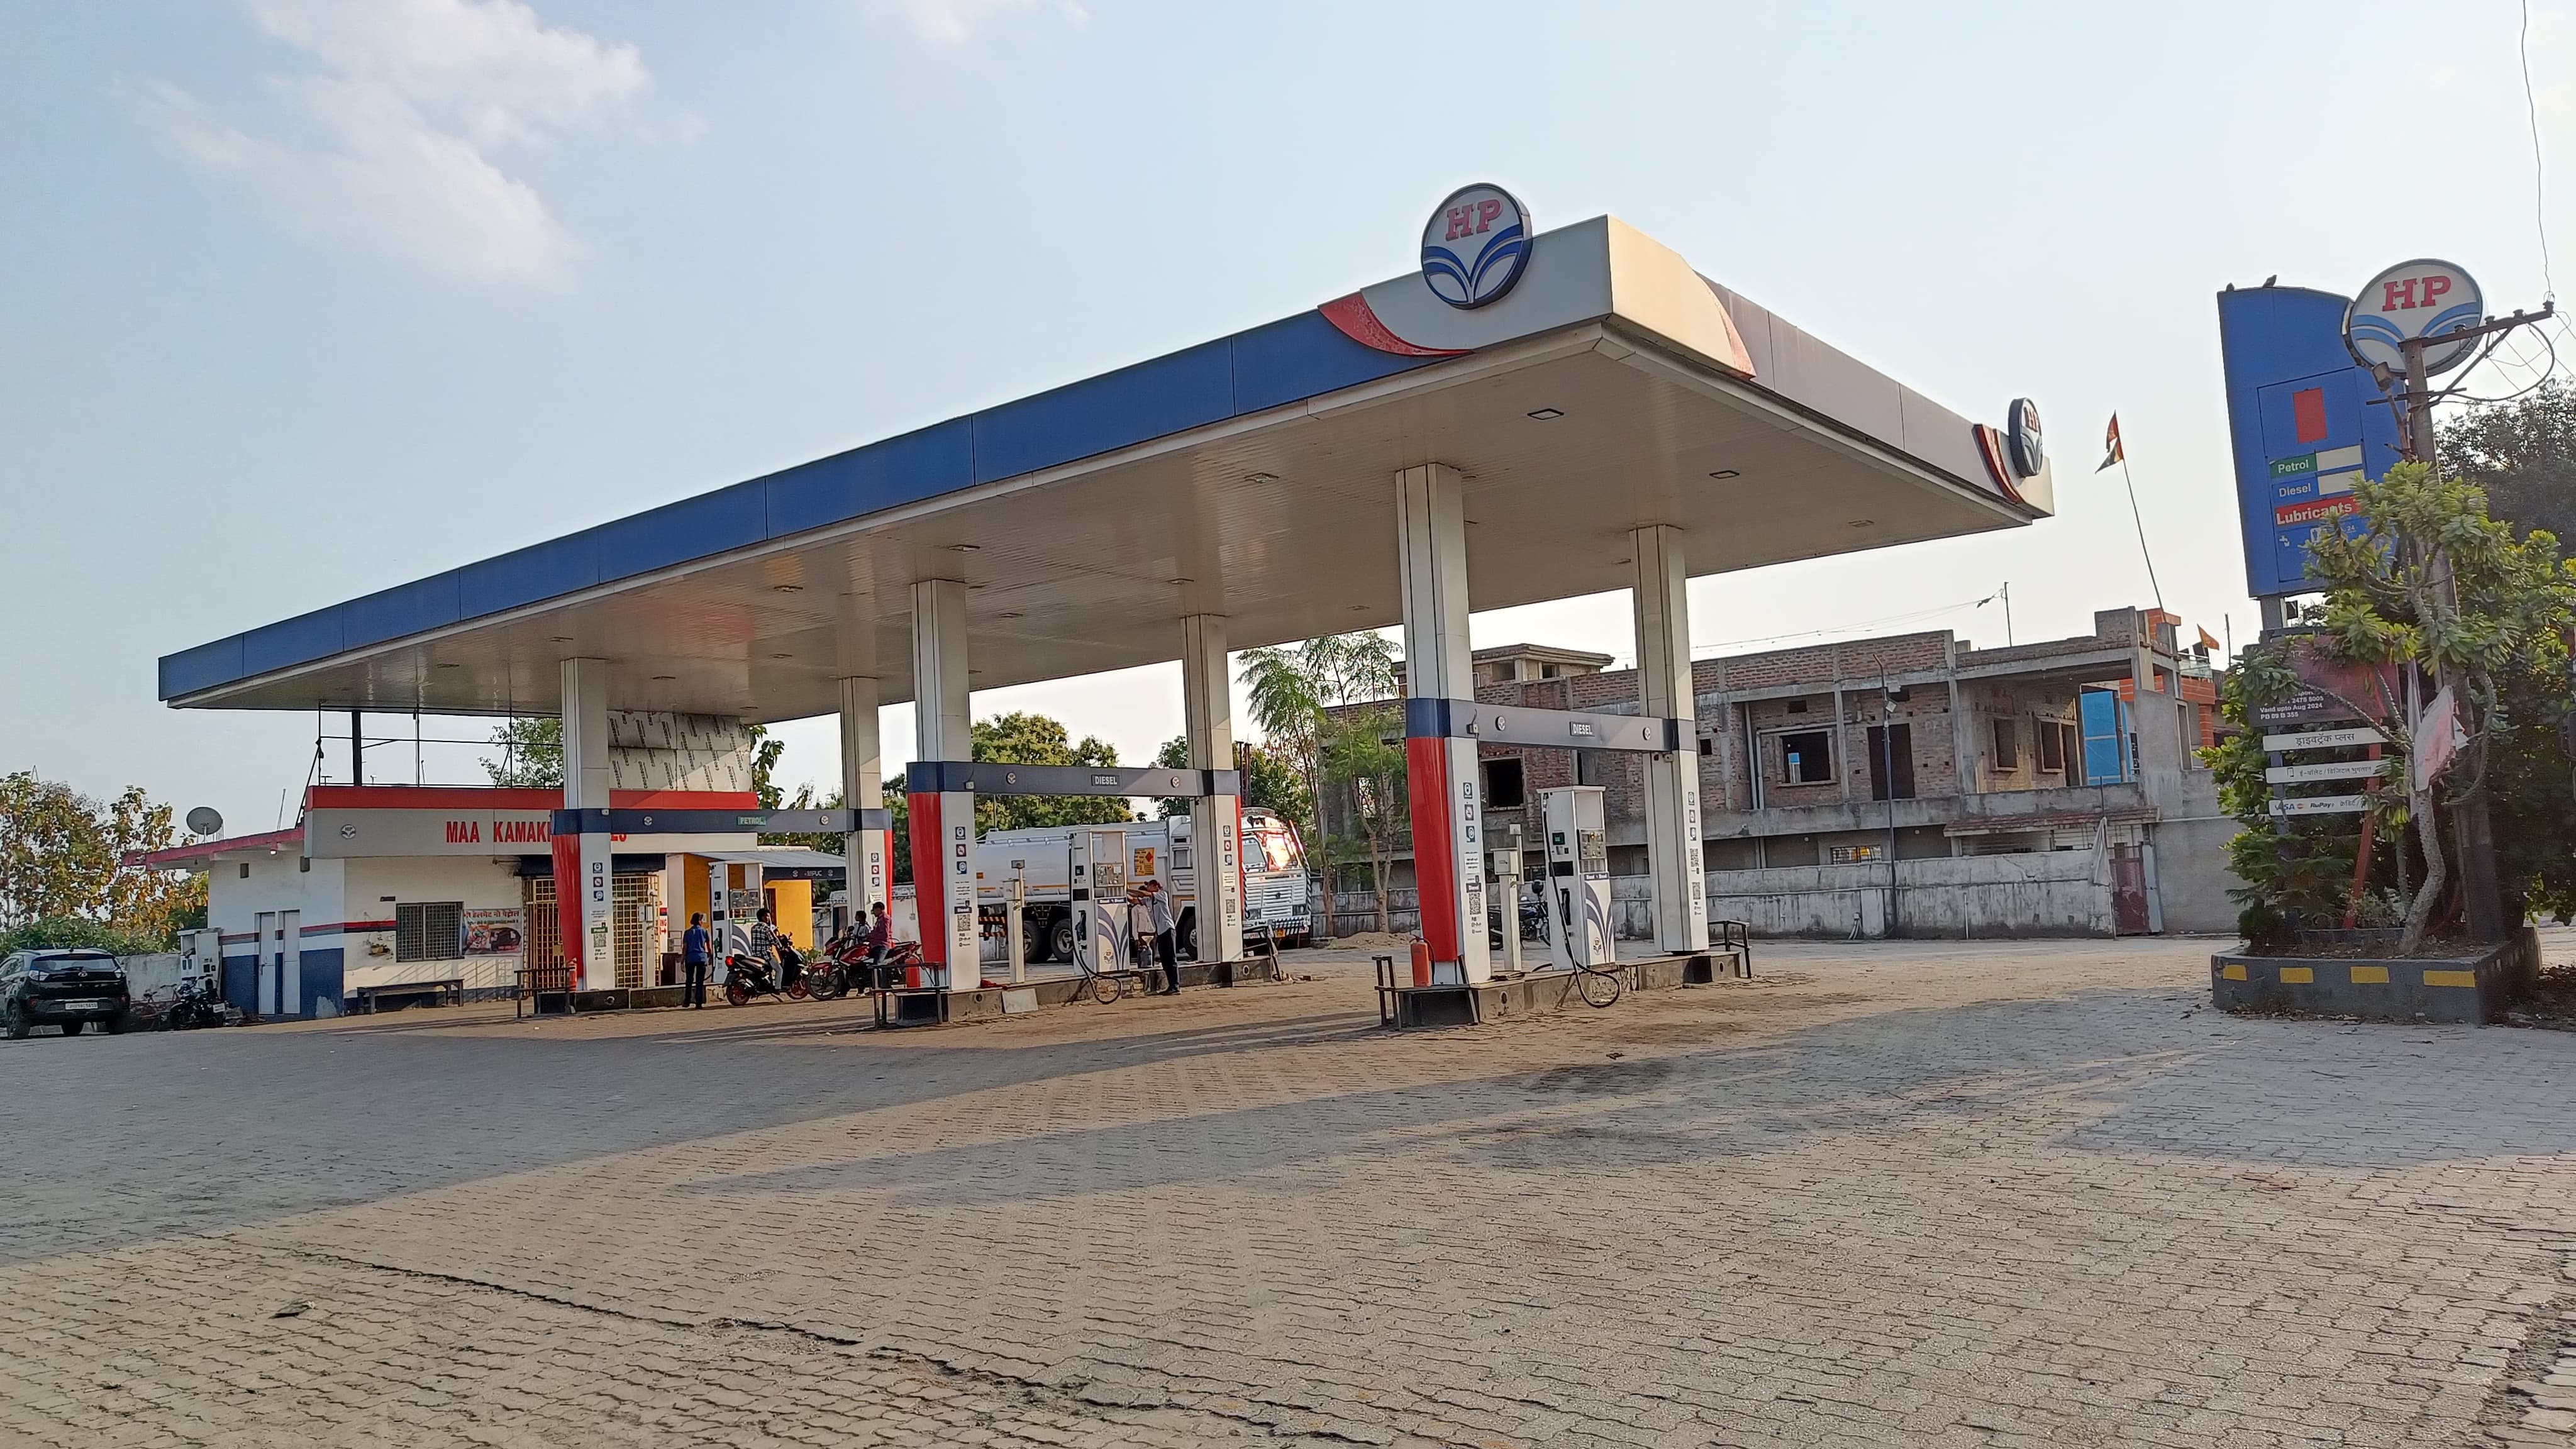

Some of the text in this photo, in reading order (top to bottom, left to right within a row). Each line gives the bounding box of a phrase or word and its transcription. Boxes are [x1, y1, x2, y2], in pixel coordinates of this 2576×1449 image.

[1445, 198, 1503, 242] HP
[2382, 275, 2451, 312] HP
[2278, 459, 2309, 474] Petrol
[2279, 482, 2311, 497] Diesel
[2276, 502, 2352, 525] Lubricants
[1573, 724, 1592, 735] DIESEL
[2334, 733, 2355, 741] प्लस
[1095, 776, 1118, 786] DIESEL
[740, 816, 765, 824] PETROL
[446, 821, 480, 843] MAA
